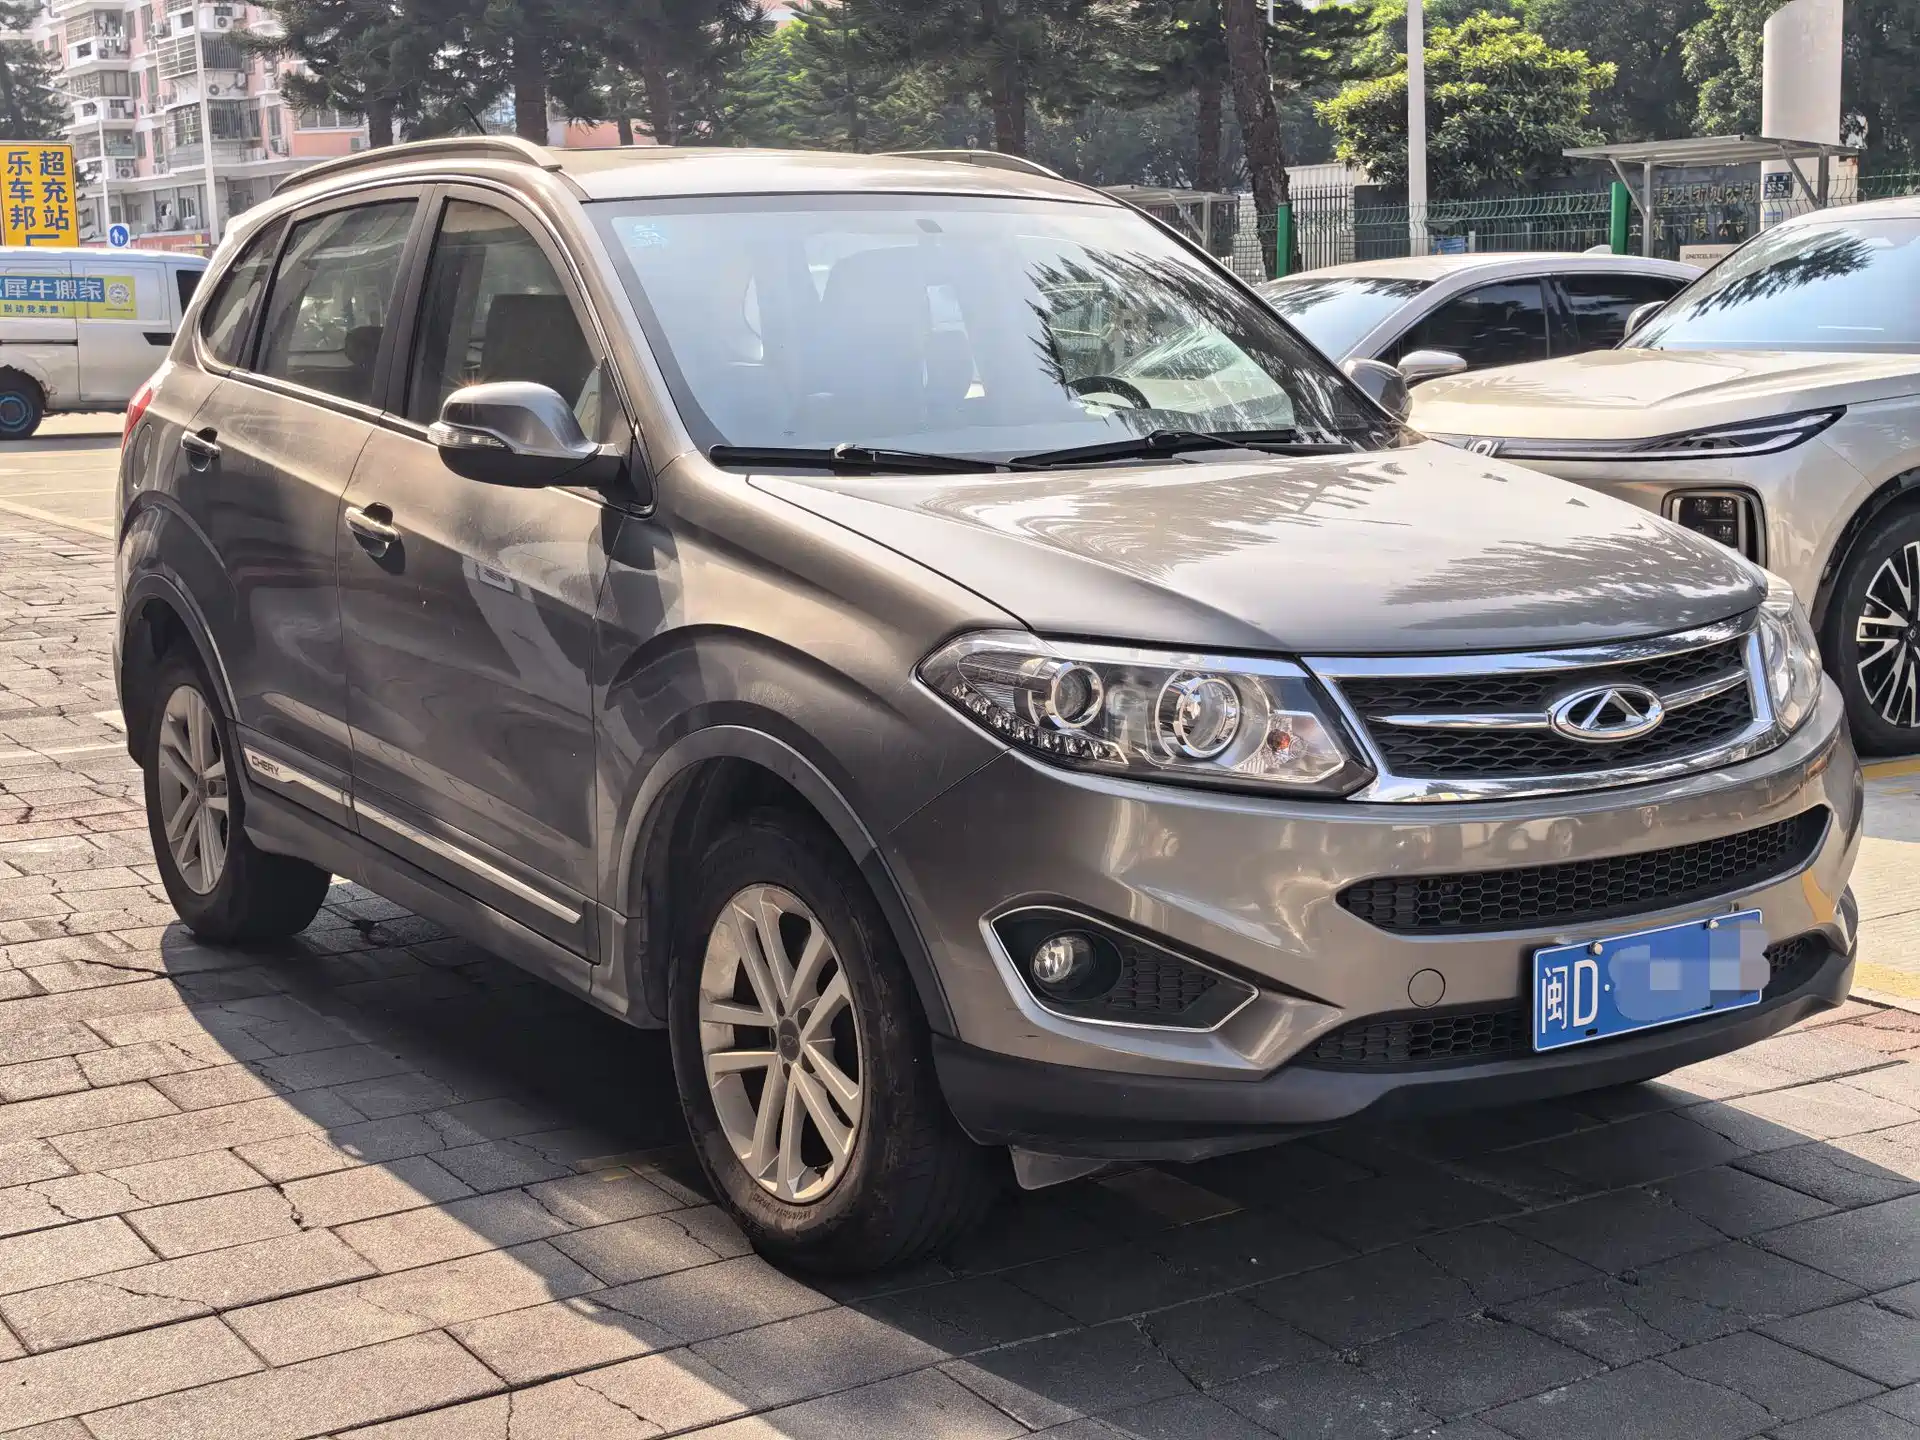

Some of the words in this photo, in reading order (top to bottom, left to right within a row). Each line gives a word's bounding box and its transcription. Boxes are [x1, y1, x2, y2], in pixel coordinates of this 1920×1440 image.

[7, 151, 36, 231] 乐车邦
[39, 150, 69, 231] 超充站
[0, 278, 101, 299] 犀牛搬家
[252, 755, 279, 775] CHERY
